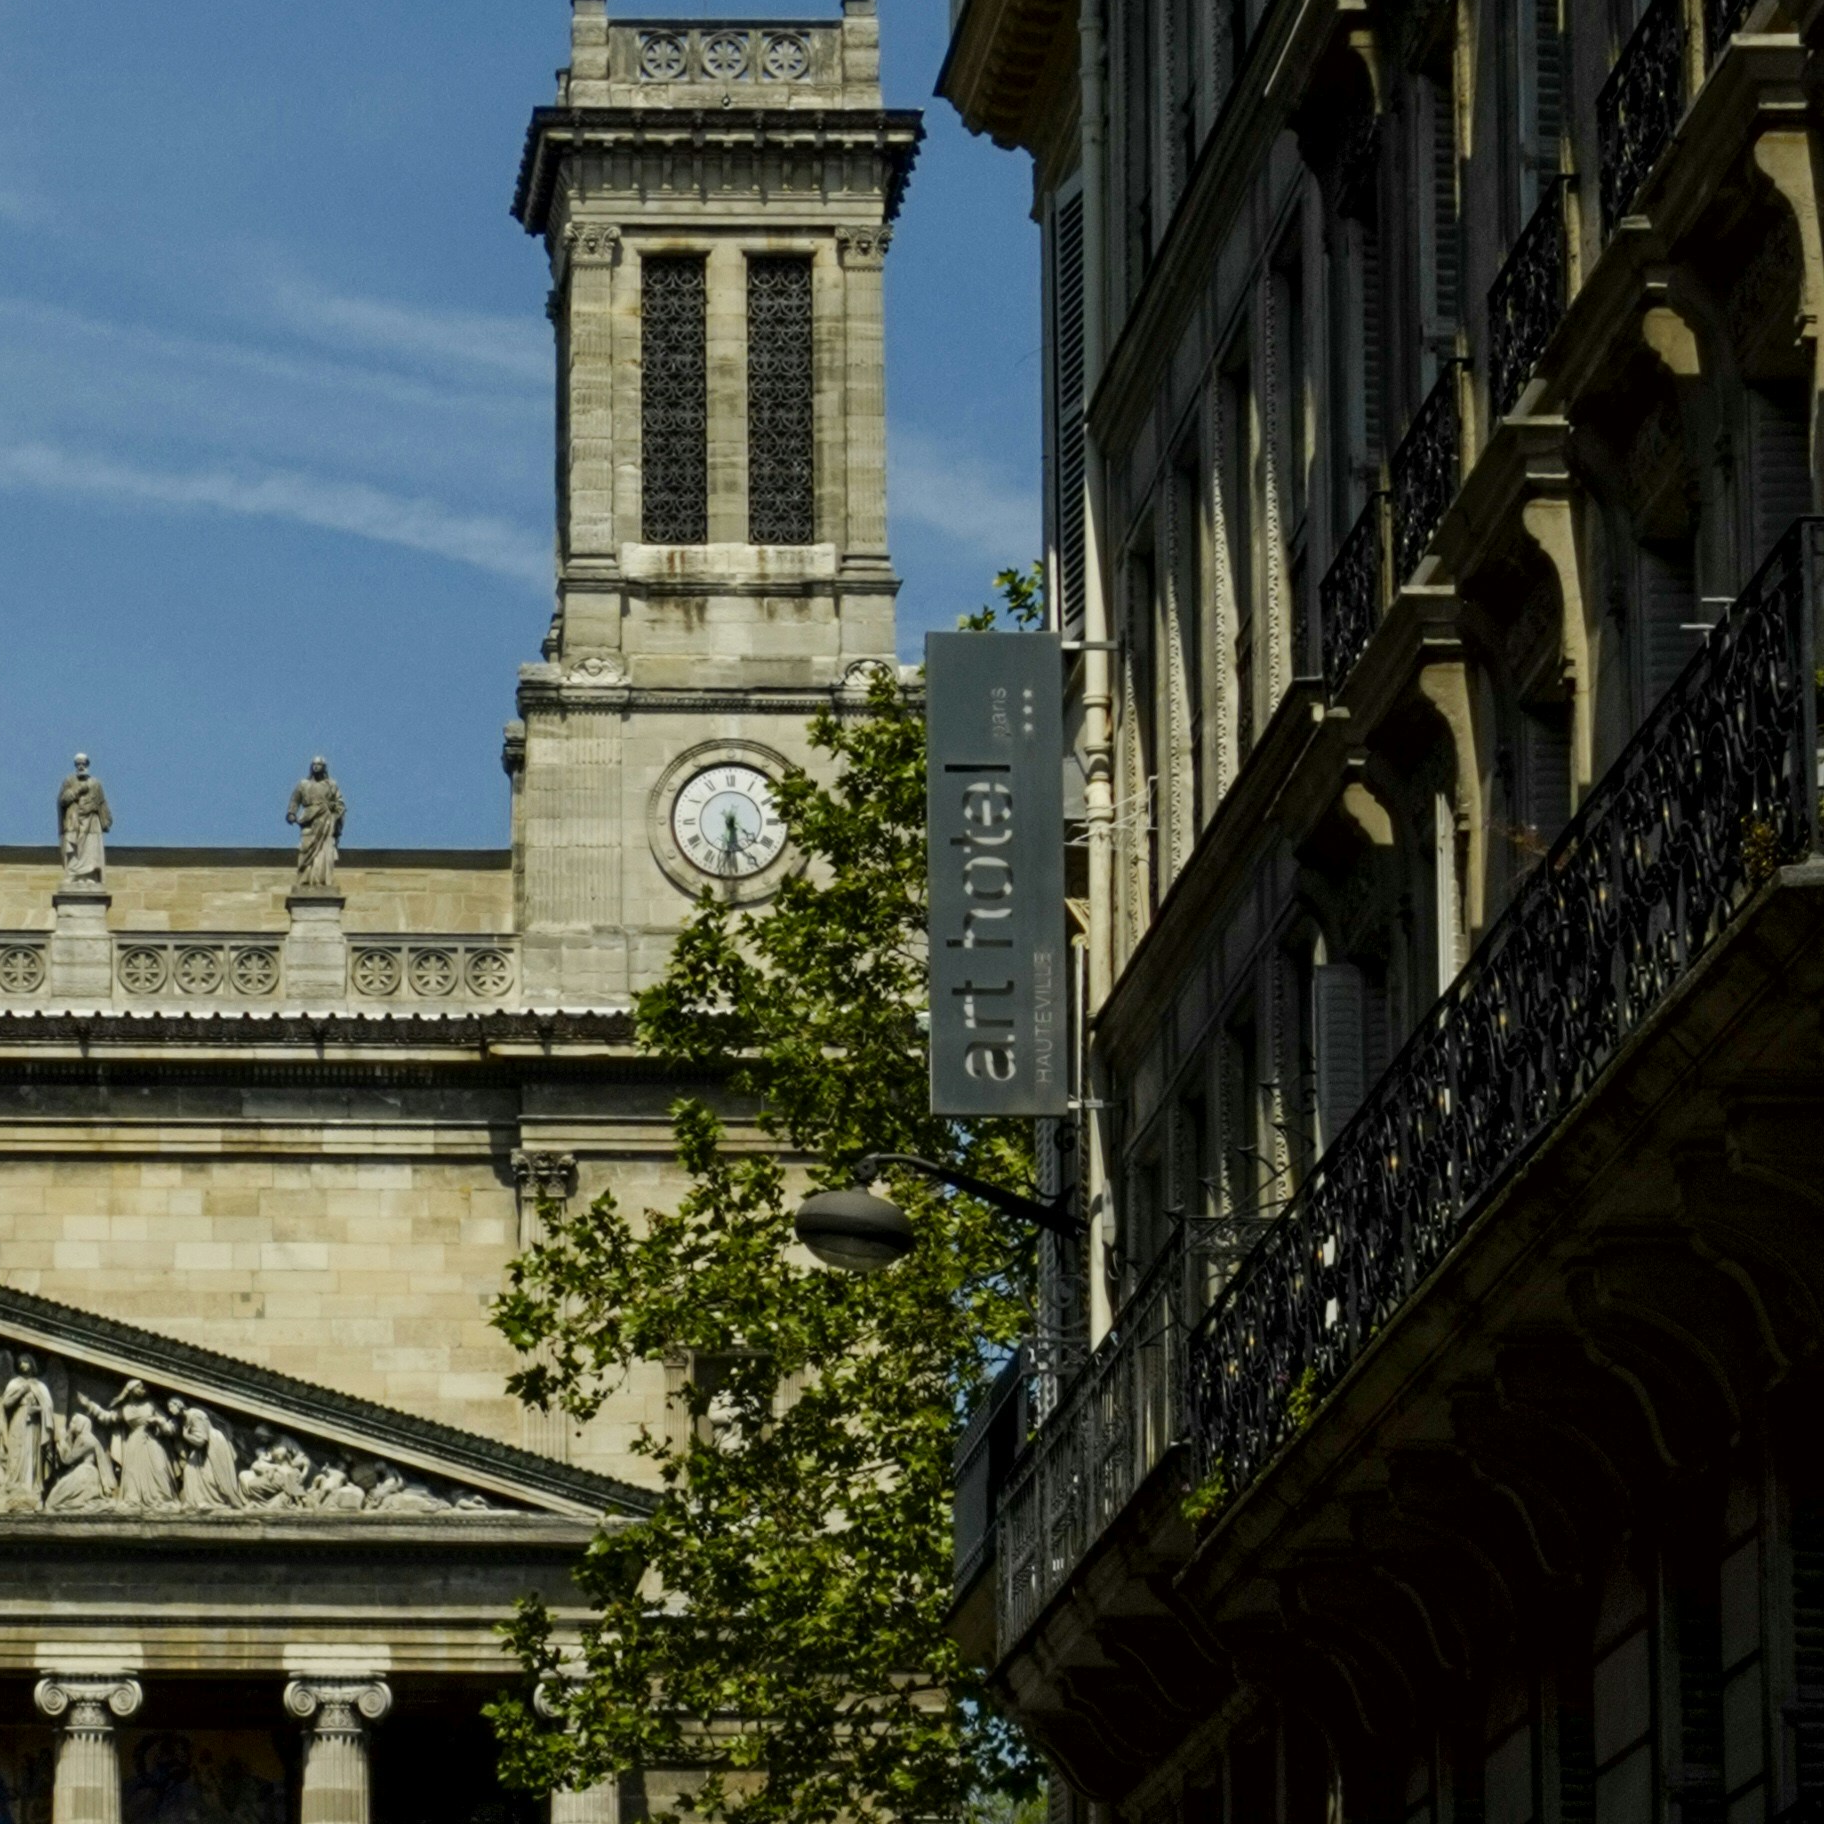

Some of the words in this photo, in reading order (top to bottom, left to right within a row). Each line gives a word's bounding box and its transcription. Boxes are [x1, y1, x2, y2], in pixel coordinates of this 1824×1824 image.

[989, 687, 1012, 738] paris
[945, 764, 1013, 948] hotel
[951, 980, 1017, 1083] art
[1033, 951, 1053, 1084] HAUTEVILLE
